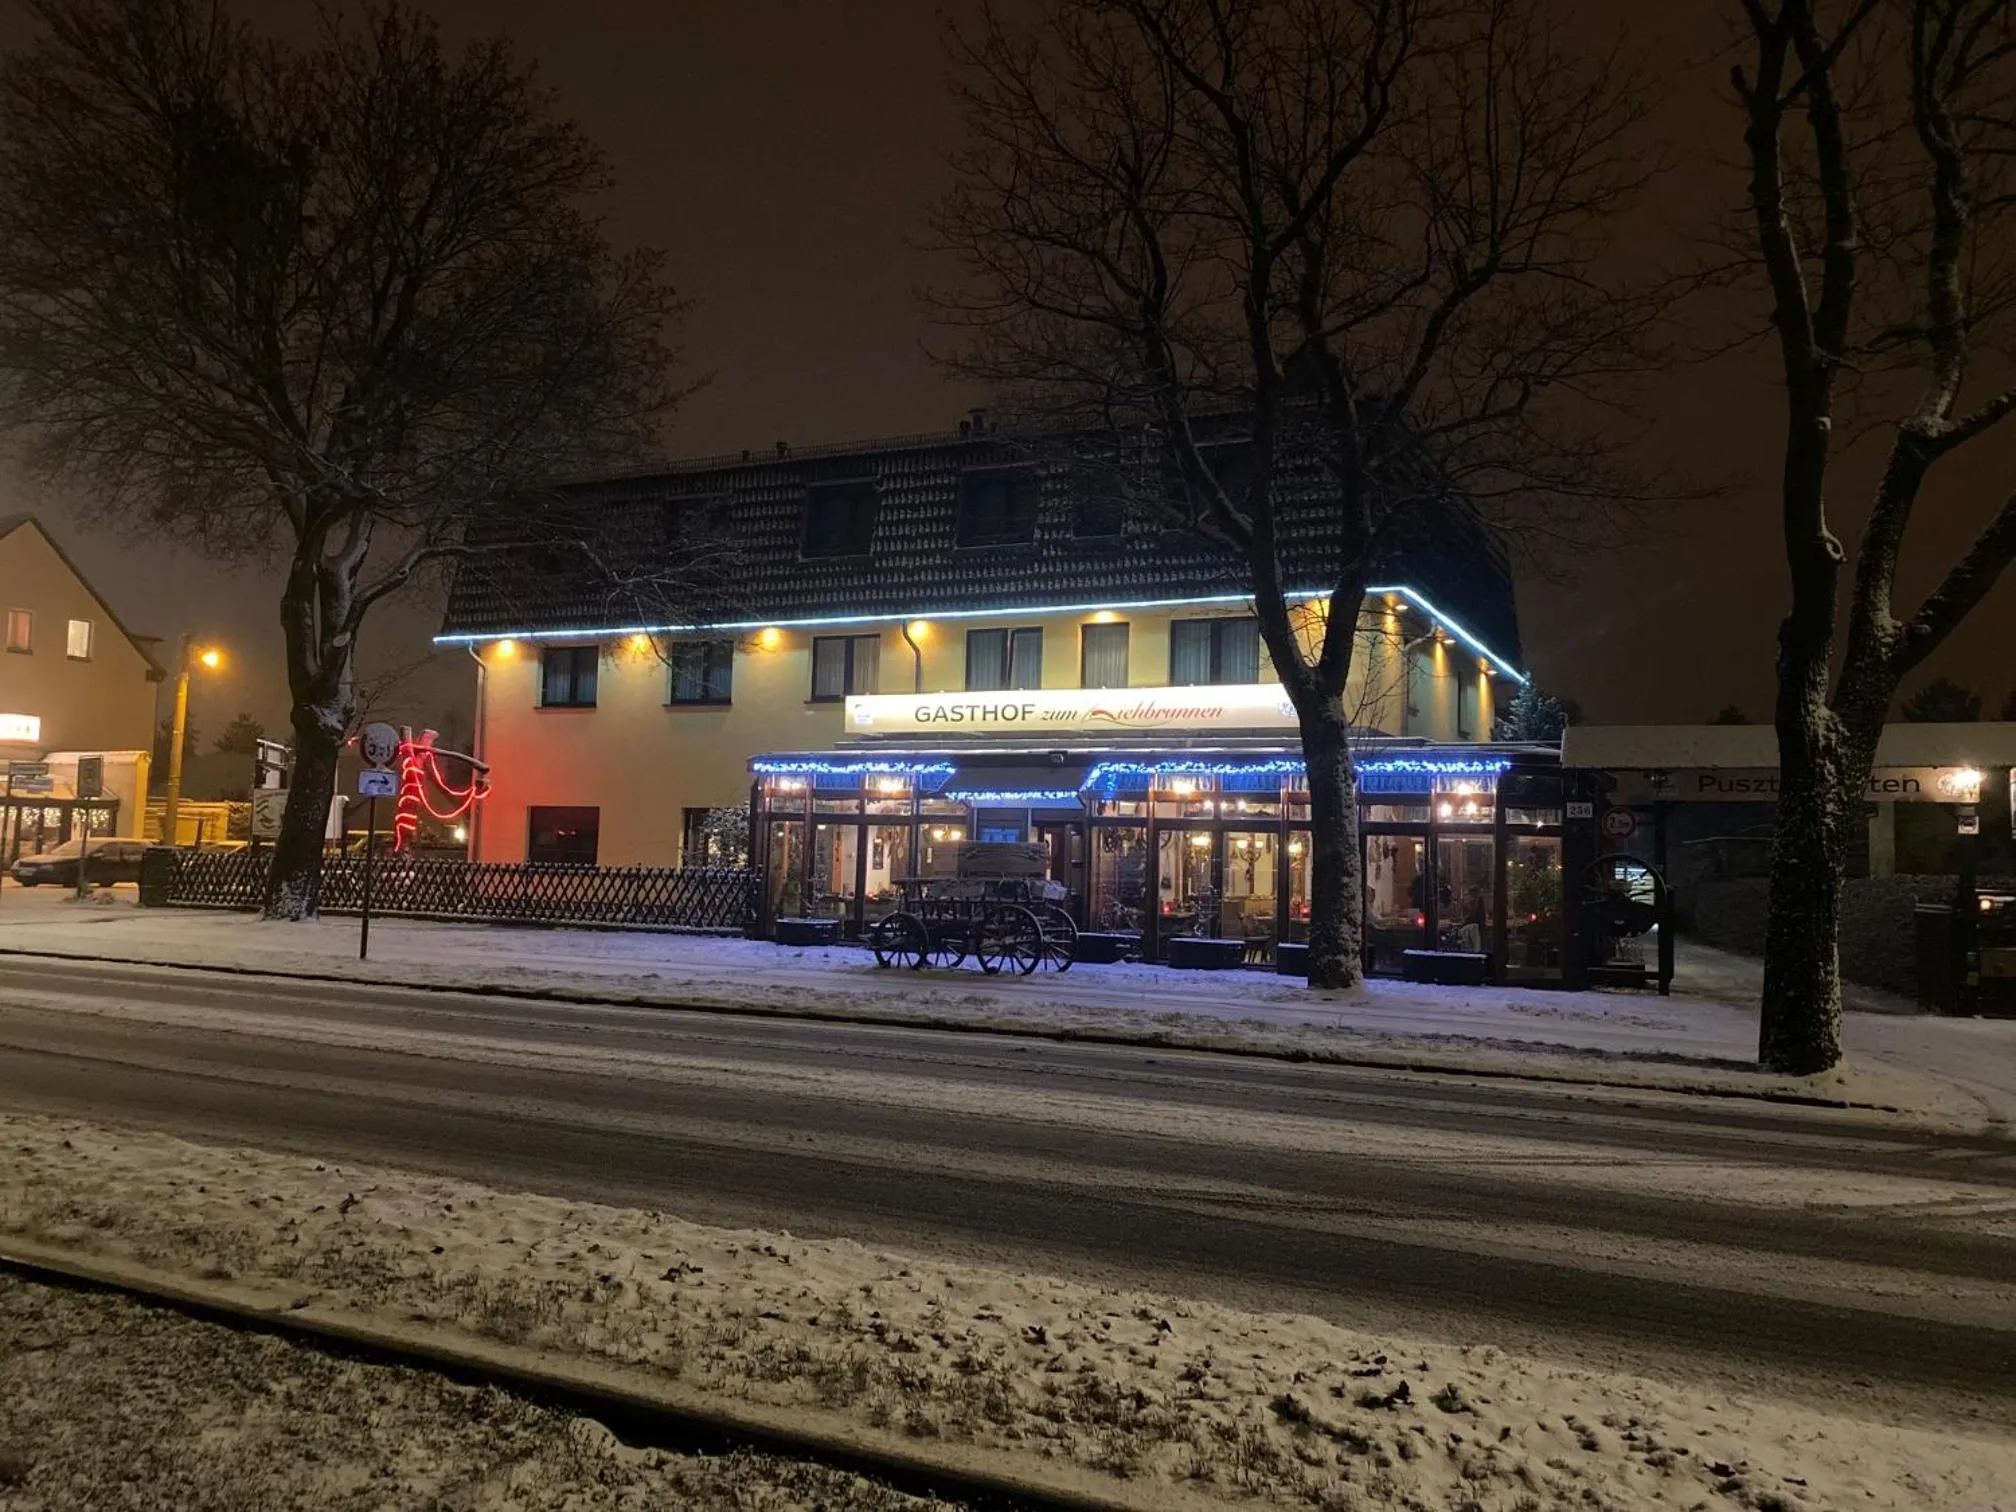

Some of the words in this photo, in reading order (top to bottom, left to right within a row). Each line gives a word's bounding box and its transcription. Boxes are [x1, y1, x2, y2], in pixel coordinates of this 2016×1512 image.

[914, 703, 1036, 723] GASTHOF
[1040, 709, 1078, 722] zum
[1697, 775, 1781, 793] Puszt
